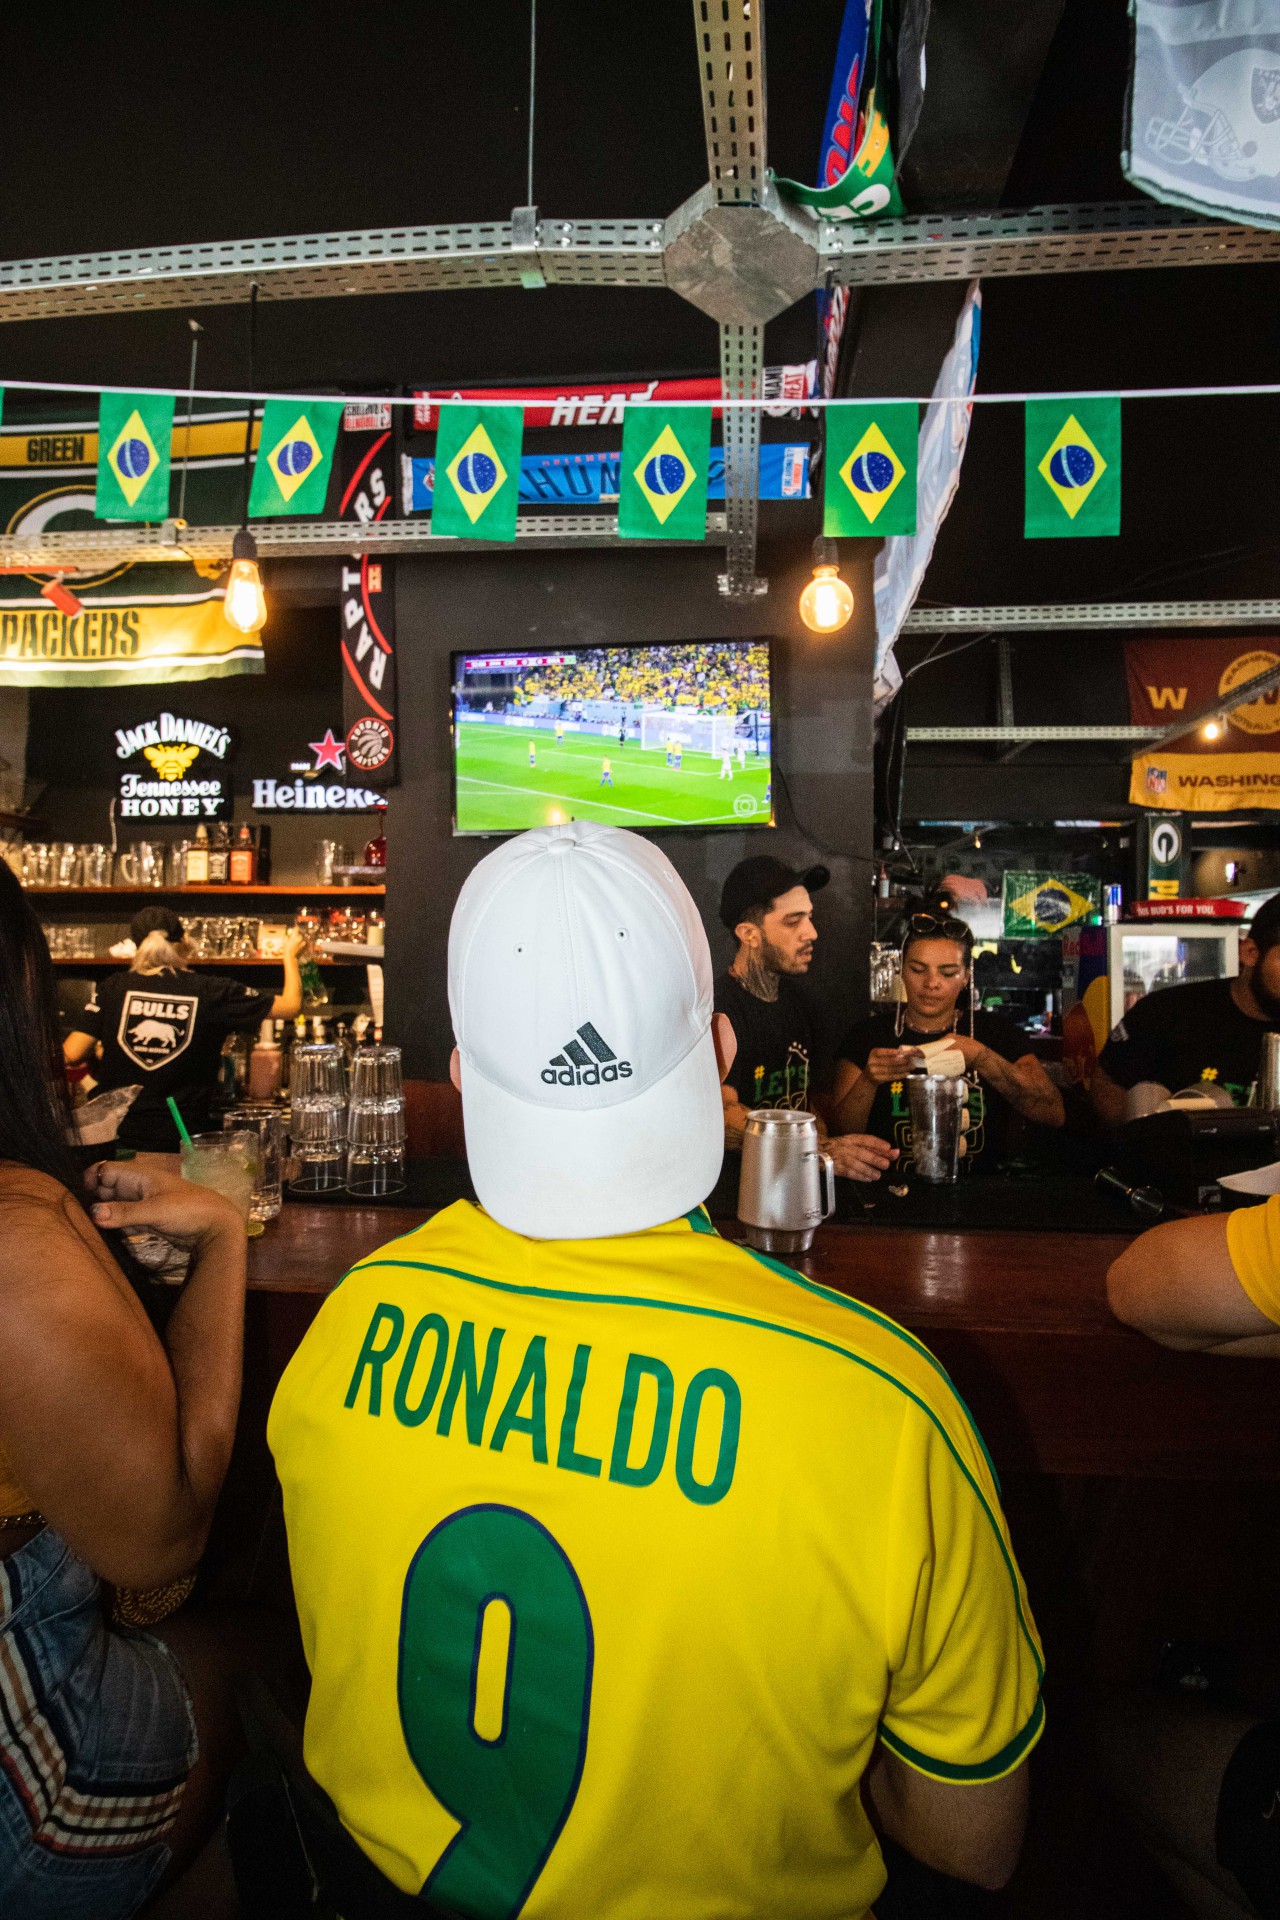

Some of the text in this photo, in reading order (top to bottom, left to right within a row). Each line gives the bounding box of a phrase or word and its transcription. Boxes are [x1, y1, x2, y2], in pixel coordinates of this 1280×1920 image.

[26, 436, 85, 462] GREEN
[541, 452, 621, 467] OKLAHOM
[342, 467, 387, 690] RAPTRS
[1, 610, 139, 657] PACKERS
[1147, 686, 1188, 710] W
[115, 712, 231, 759] JACK DANIEL'S
[350, 720, 389, 741] TORONTO
[351, 746, 389, 767] RAPTORS
[120, 773, 222, 798] Tennessee
[120, 798, 224, 817] HONEY
[1175, 904, 1194, 914] FOR
[130, 1000, 190, 1020] BULLS
[540, 1060, 633, 1086] adidas
[344, 1302, 742, 1506] RONALDO
[398, 1502, 595, 1920] 9
